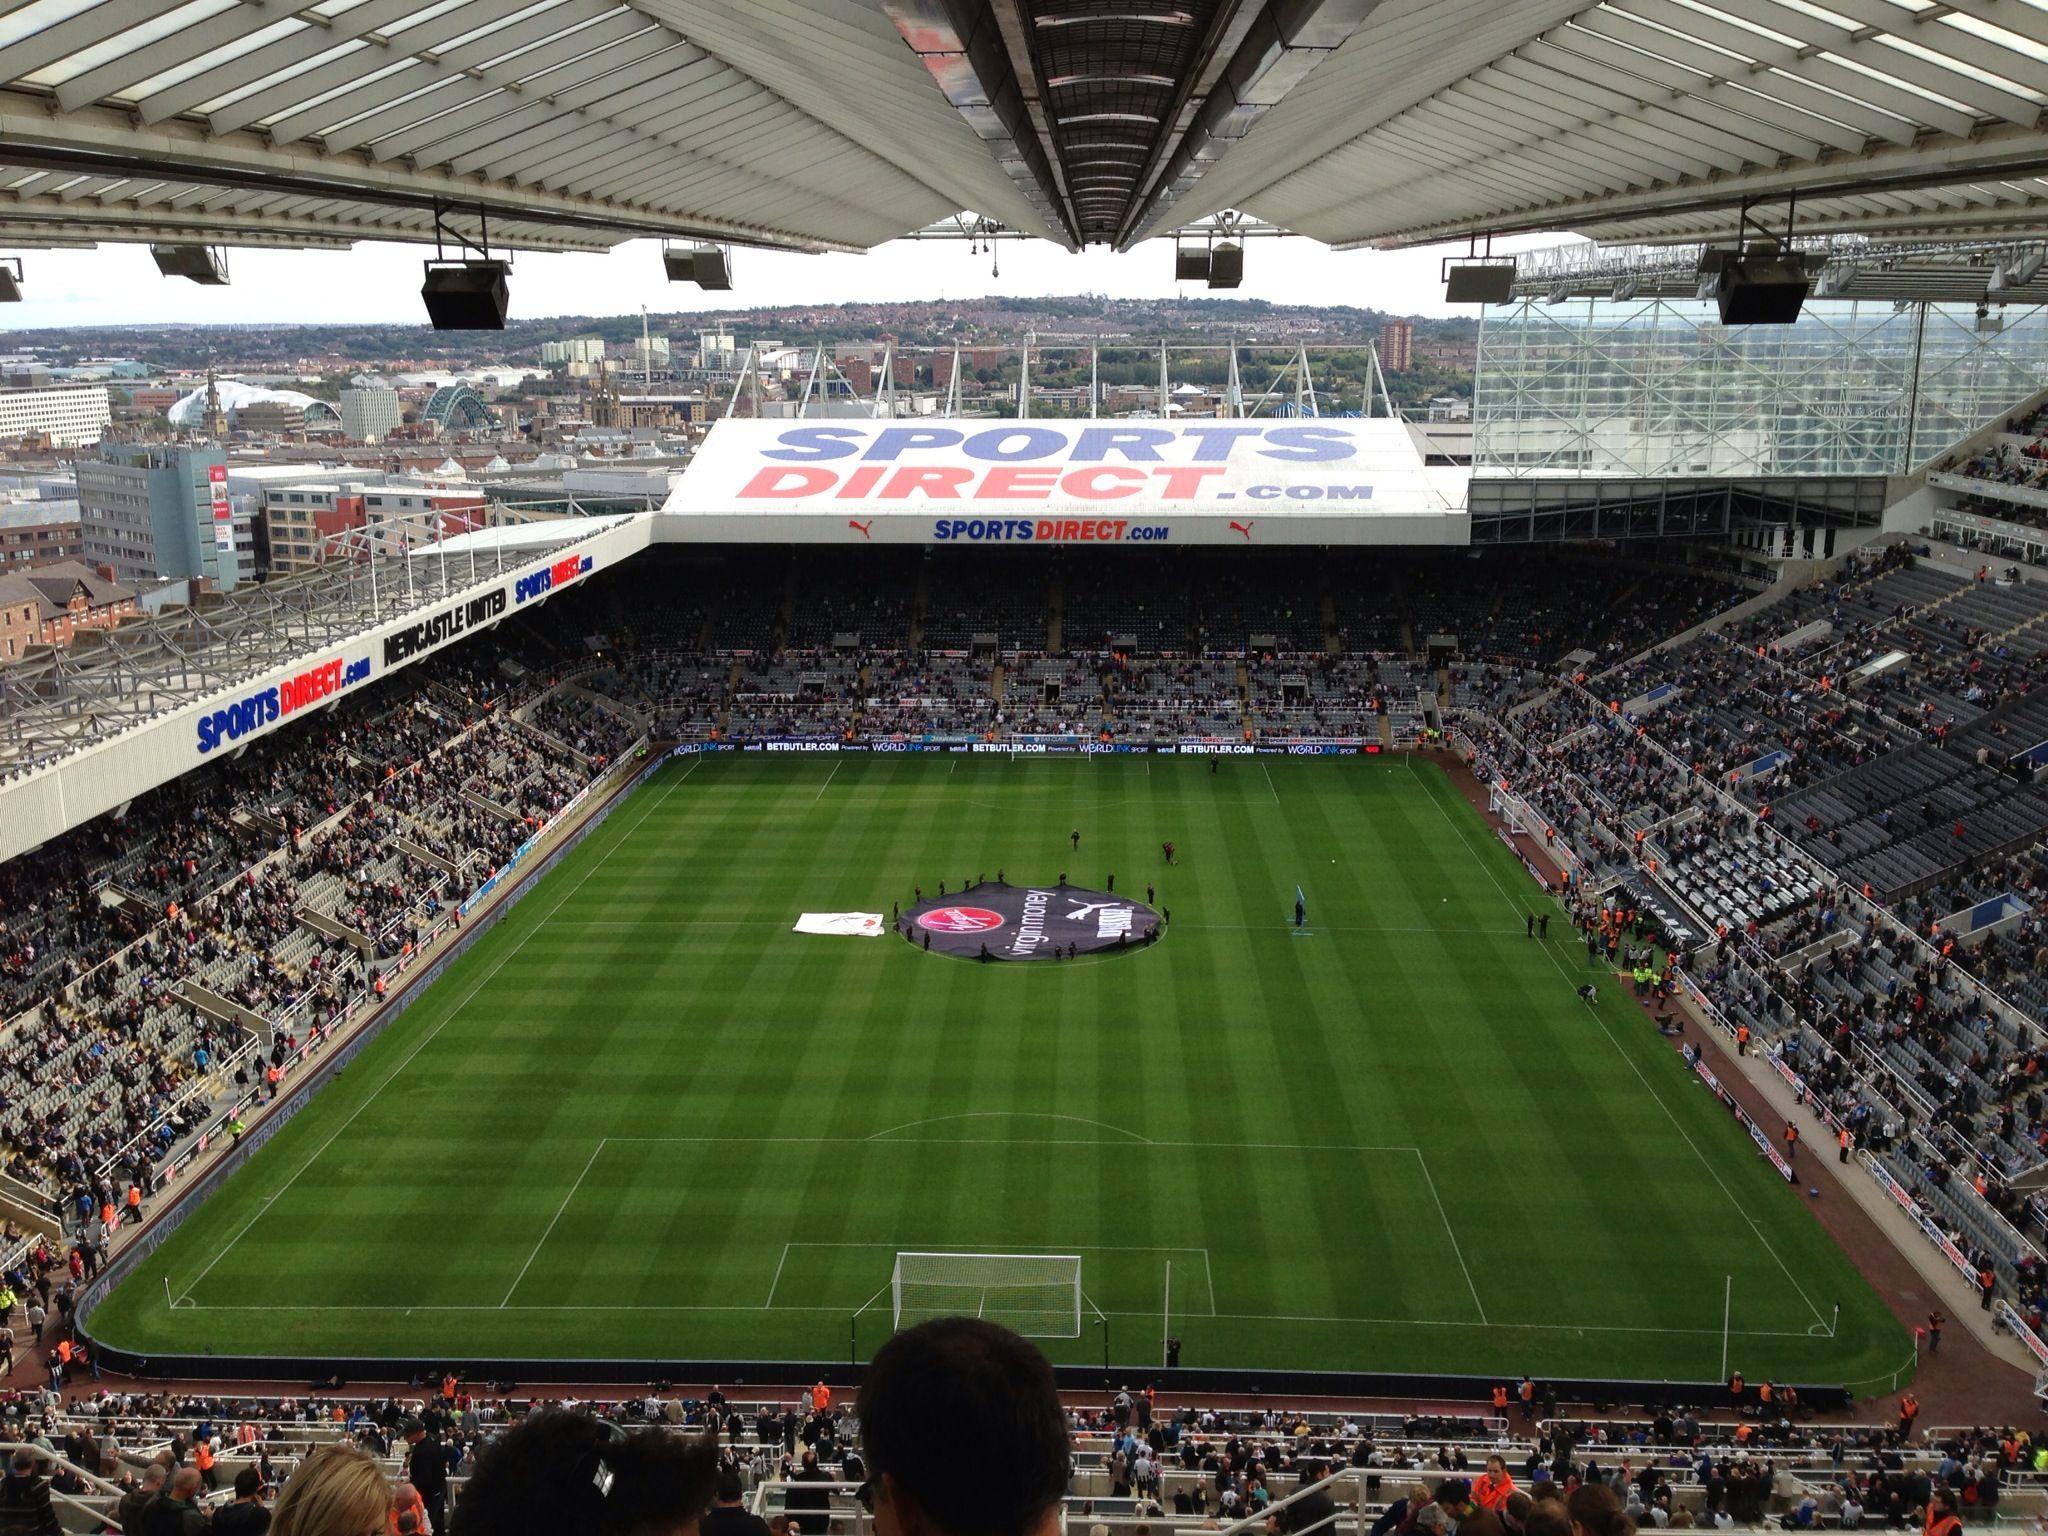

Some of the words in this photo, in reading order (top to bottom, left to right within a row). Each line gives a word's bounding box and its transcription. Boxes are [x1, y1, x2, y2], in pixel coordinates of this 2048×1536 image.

[759, 427, 1358, 462] SPORTS
[734, 466, 1374, 500] DIRECT.COM
[933, 519, 1169, 540] SPORTSDIRECT.COM
[383, 605, 463, 667] NEWCASTLE
[465, 587, 506, 628] UNITED
[766, 743, 840, 751] BETBUTLER.COM
[972, 744, 1046, 752] BETBUTLER.COM
[1180, 745, 1254, 754] BETBUTLER.COM
